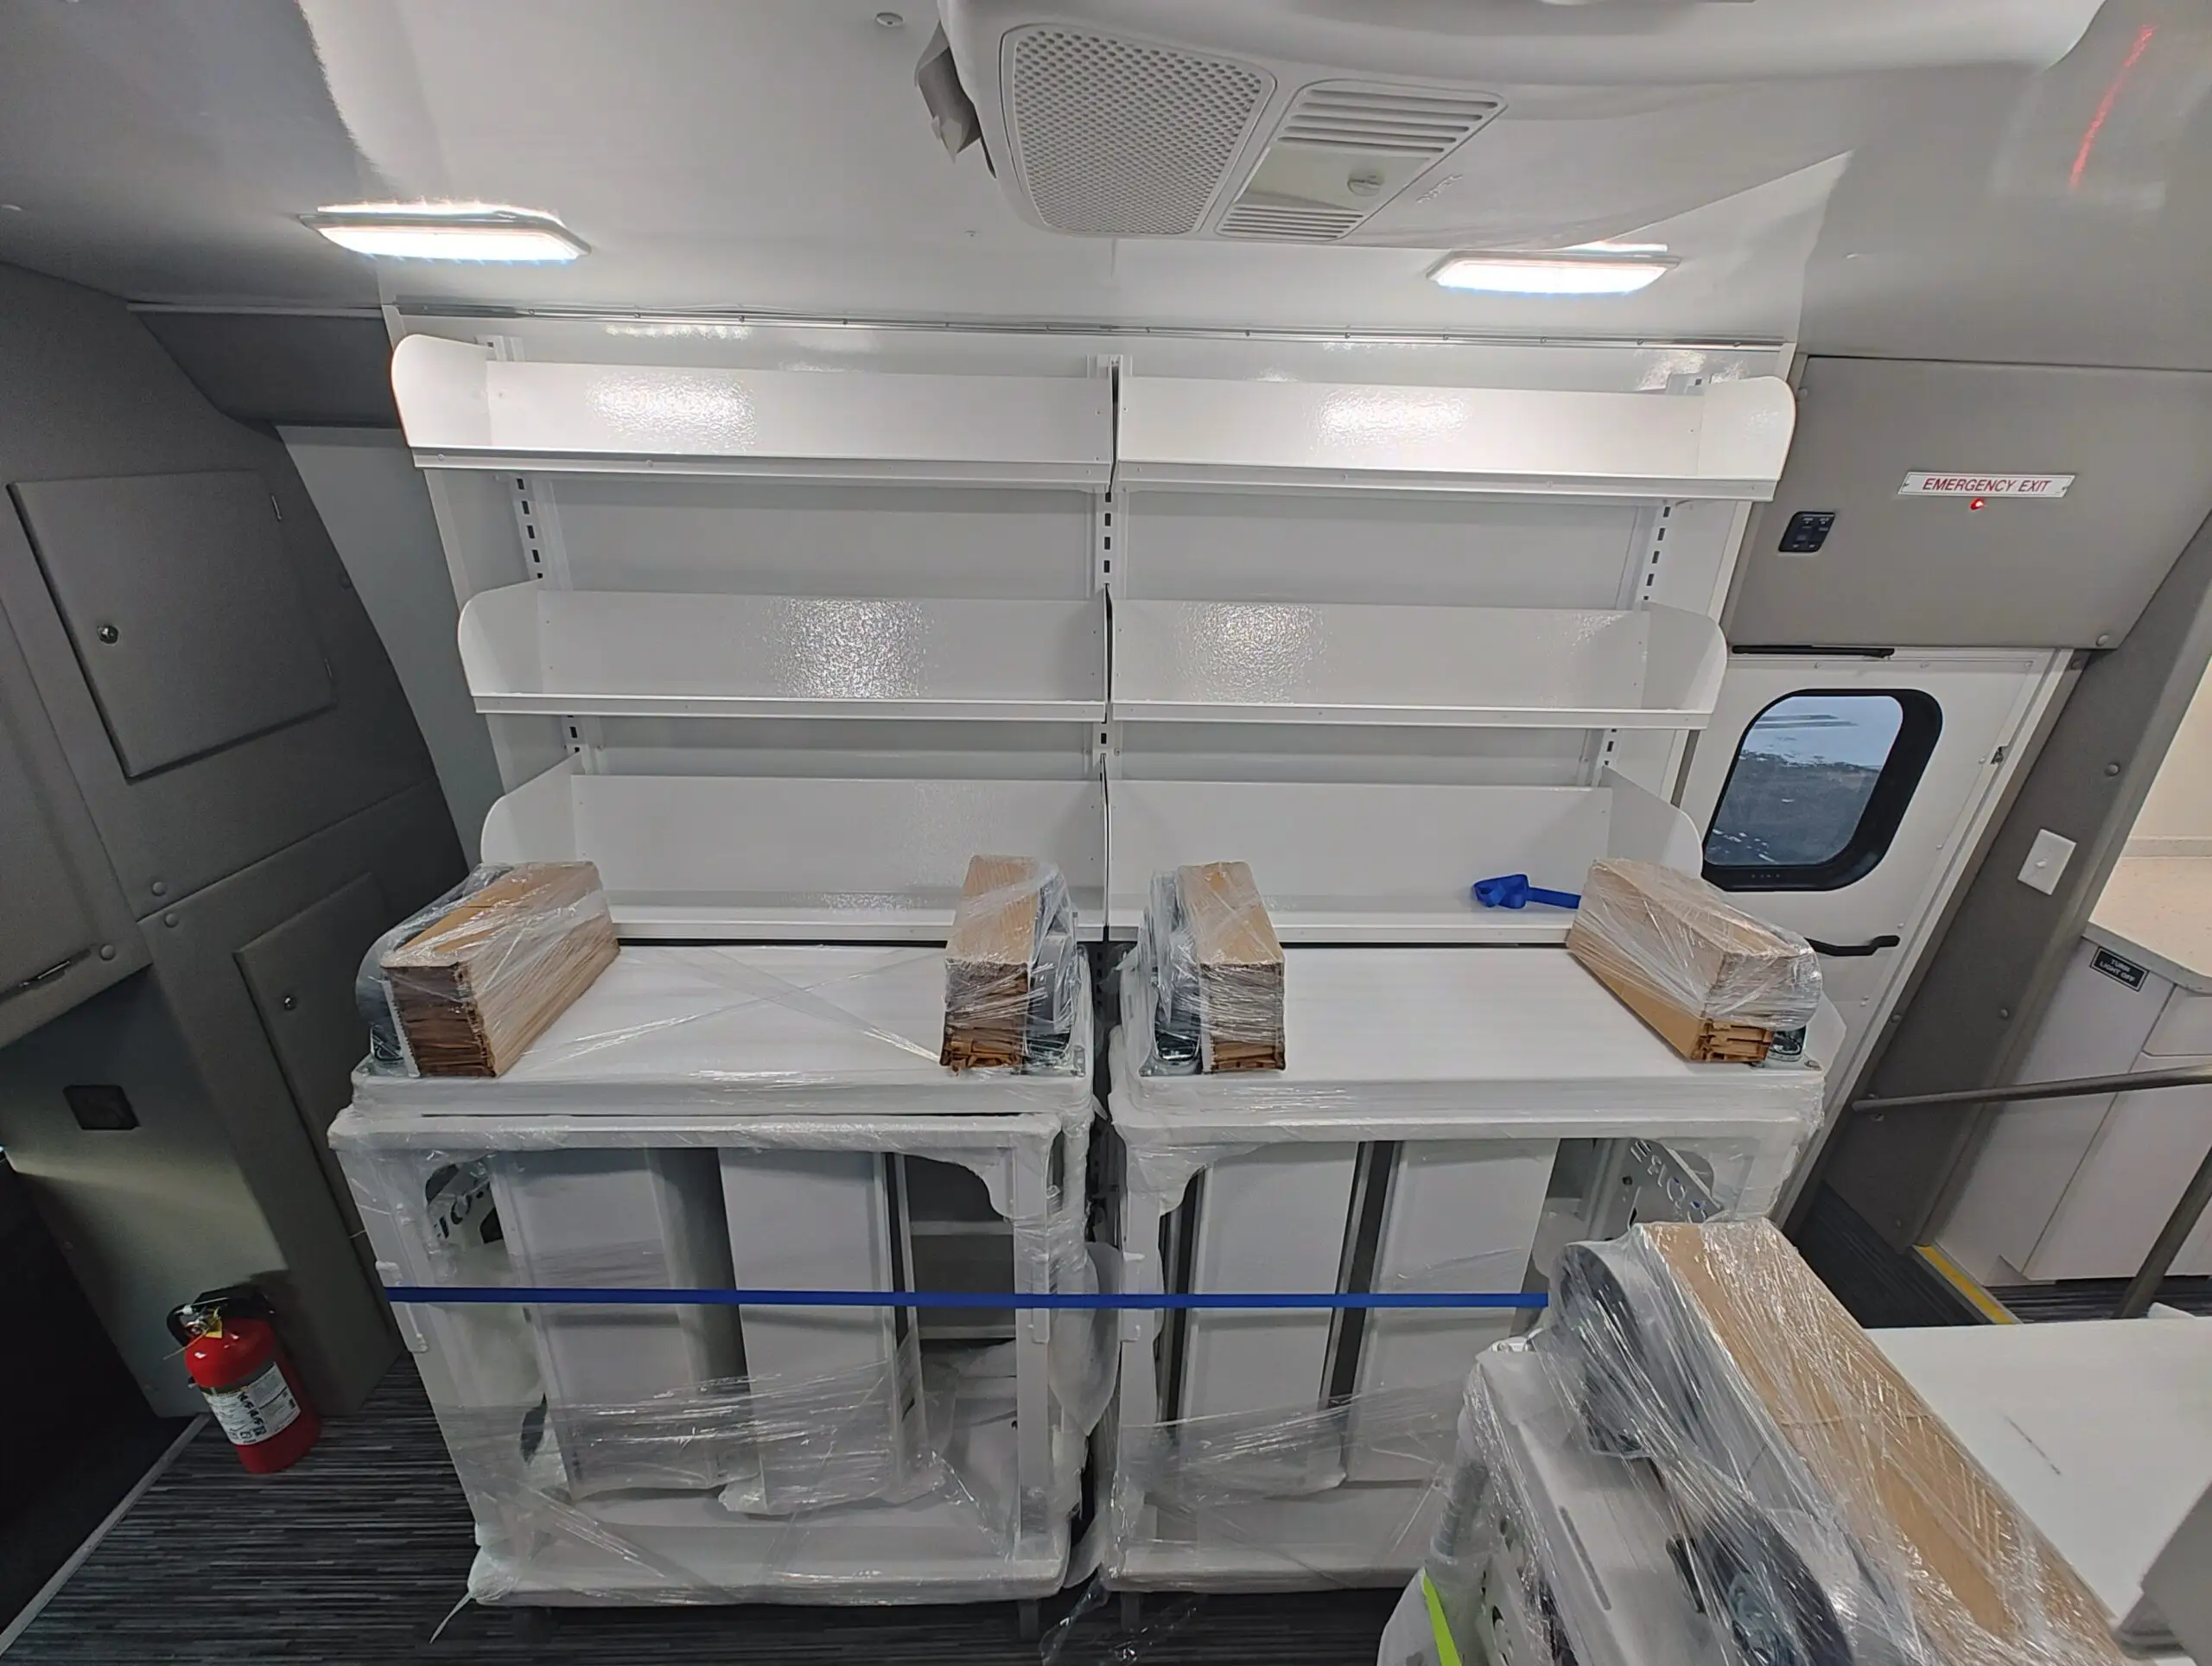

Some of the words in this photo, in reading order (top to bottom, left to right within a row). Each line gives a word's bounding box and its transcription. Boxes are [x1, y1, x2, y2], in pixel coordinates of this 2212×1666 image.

[1923, 478, 2017, 492] EMERGENCY
[2018, 480, 2052, 493] EXIT
[2100, 961, 2120, 975] LIGHT
[2120, 972, 2135, 982] OFF
[2111, 959, 2131, 972] TURN
